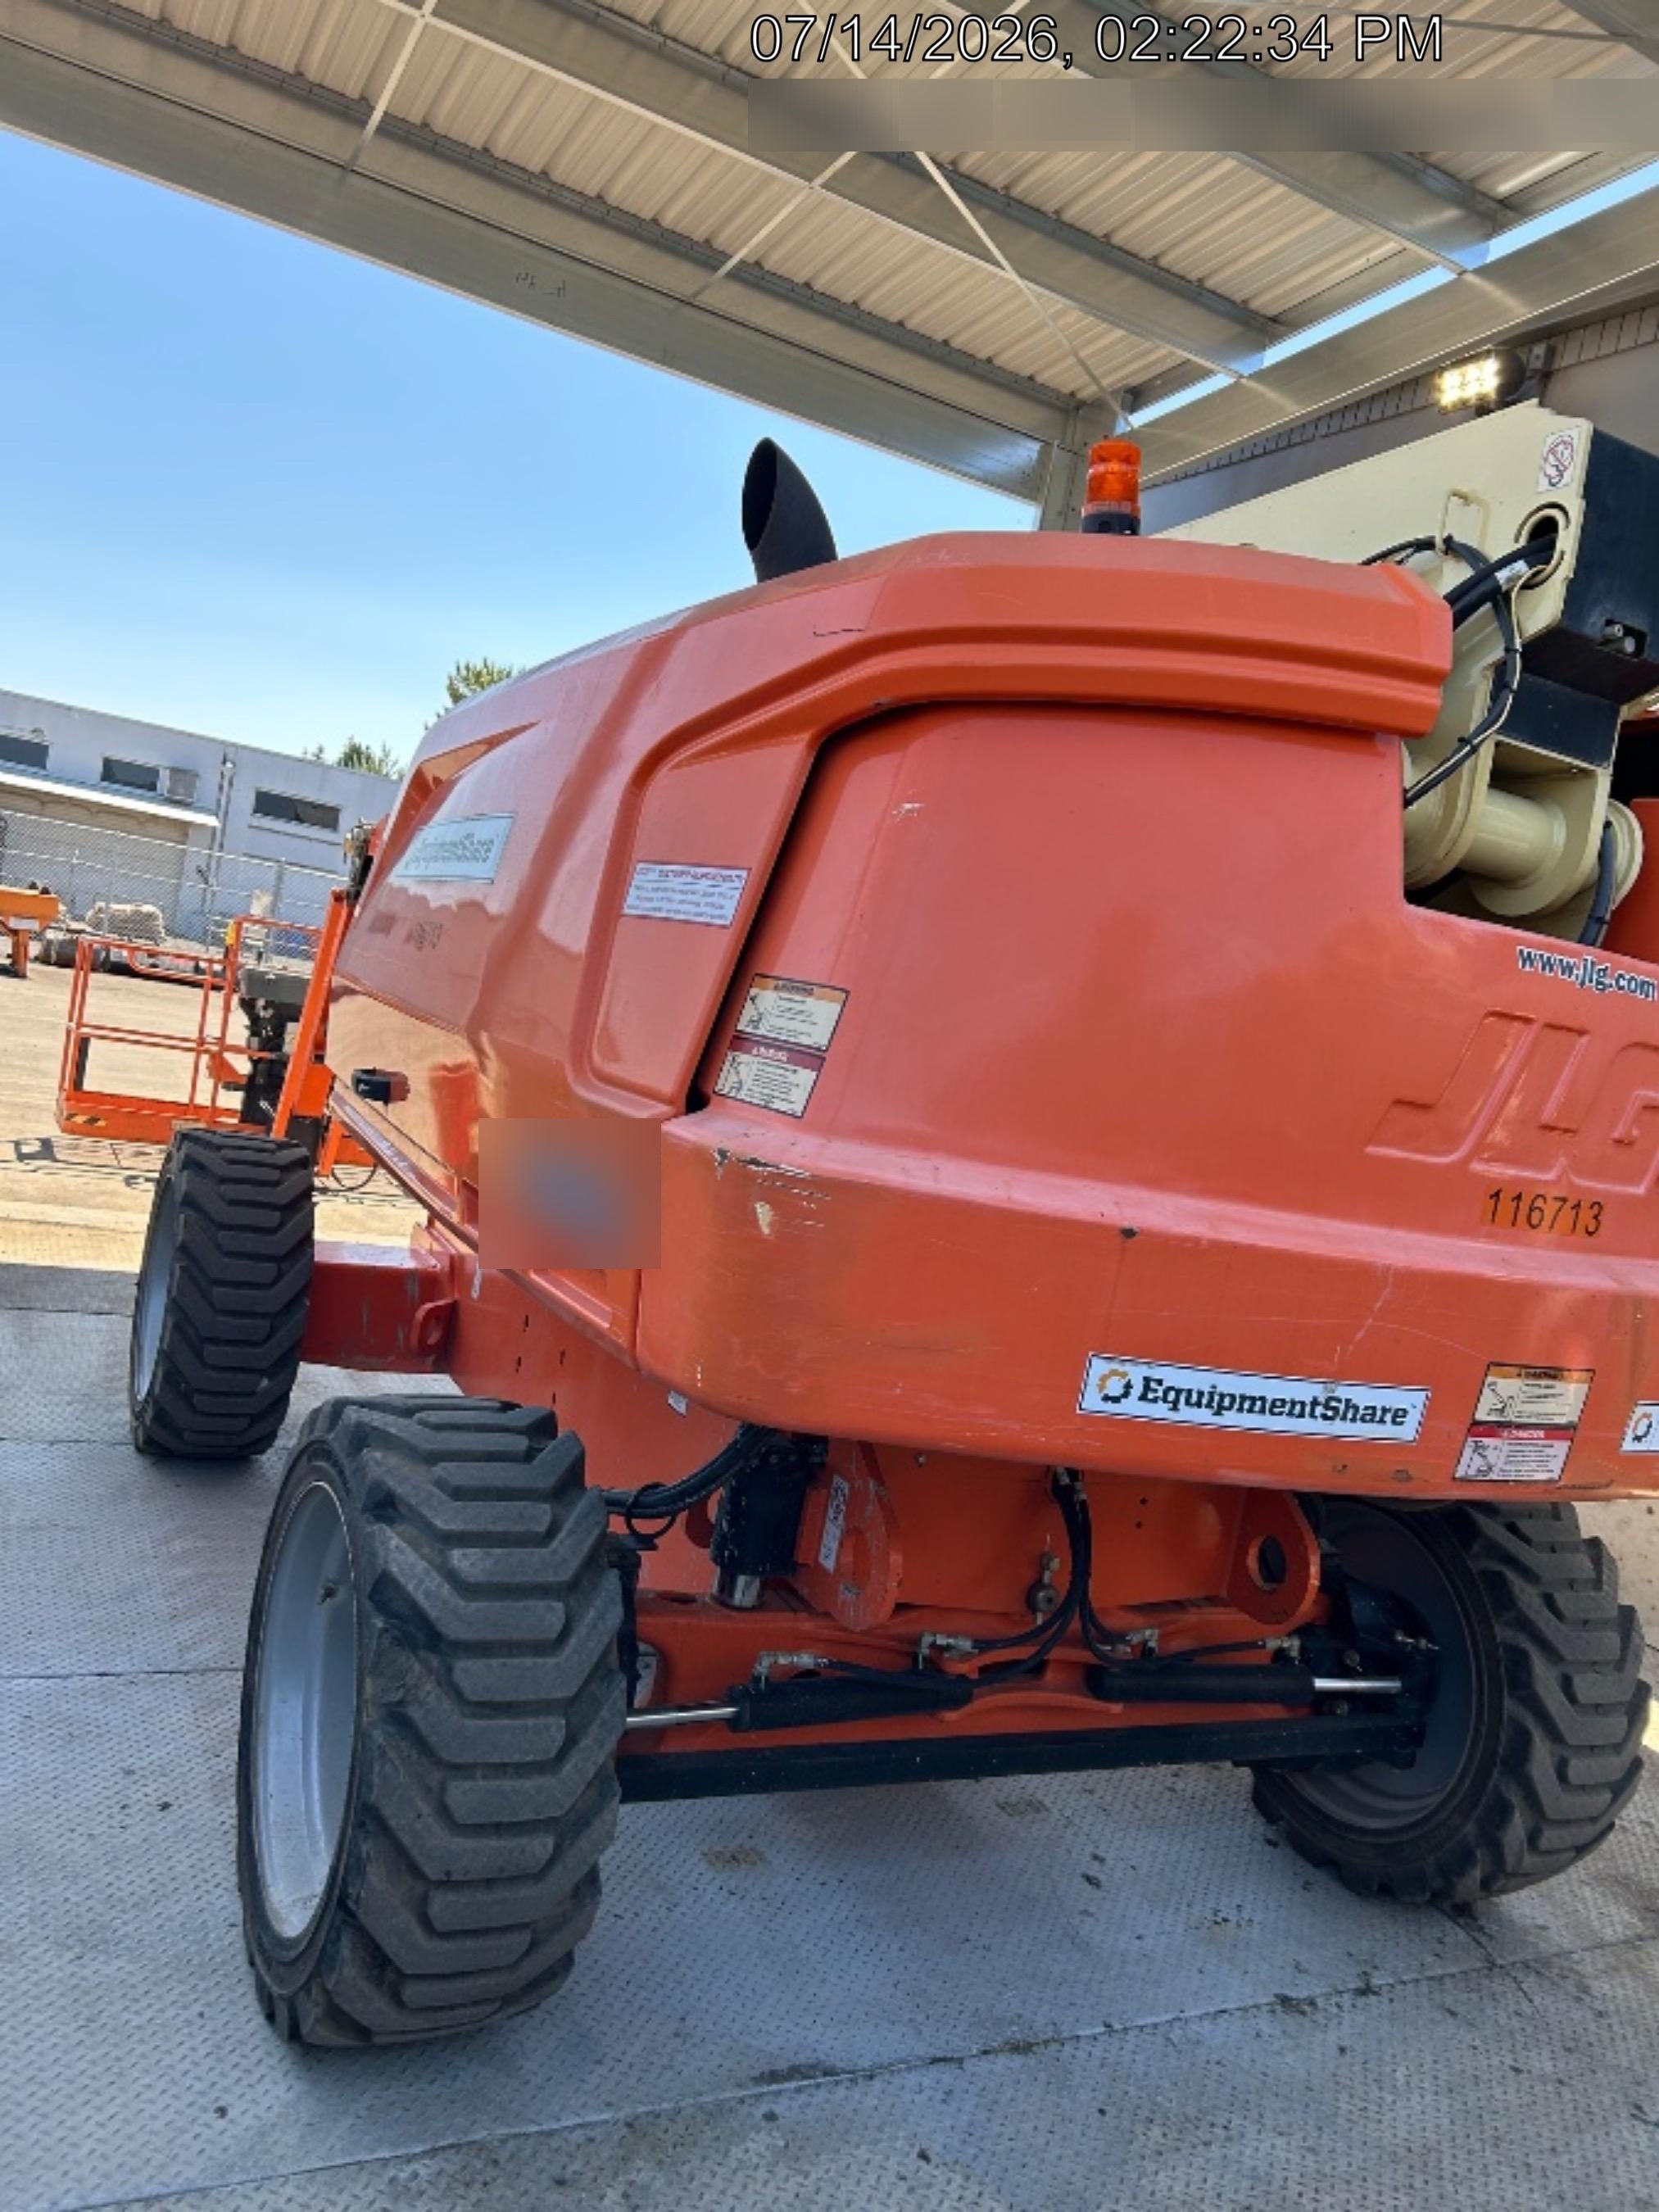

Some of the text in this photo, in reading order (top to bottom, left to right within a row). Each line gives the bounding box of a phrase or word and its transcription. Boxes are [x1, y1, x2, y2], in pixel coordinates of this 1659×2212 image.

[1517, 945, 1657, 1001] www.jlg.com
[1489, 1187, 1604, 1236] 116713
[1138, 1376, 1409, 1427] EquipmentShare
